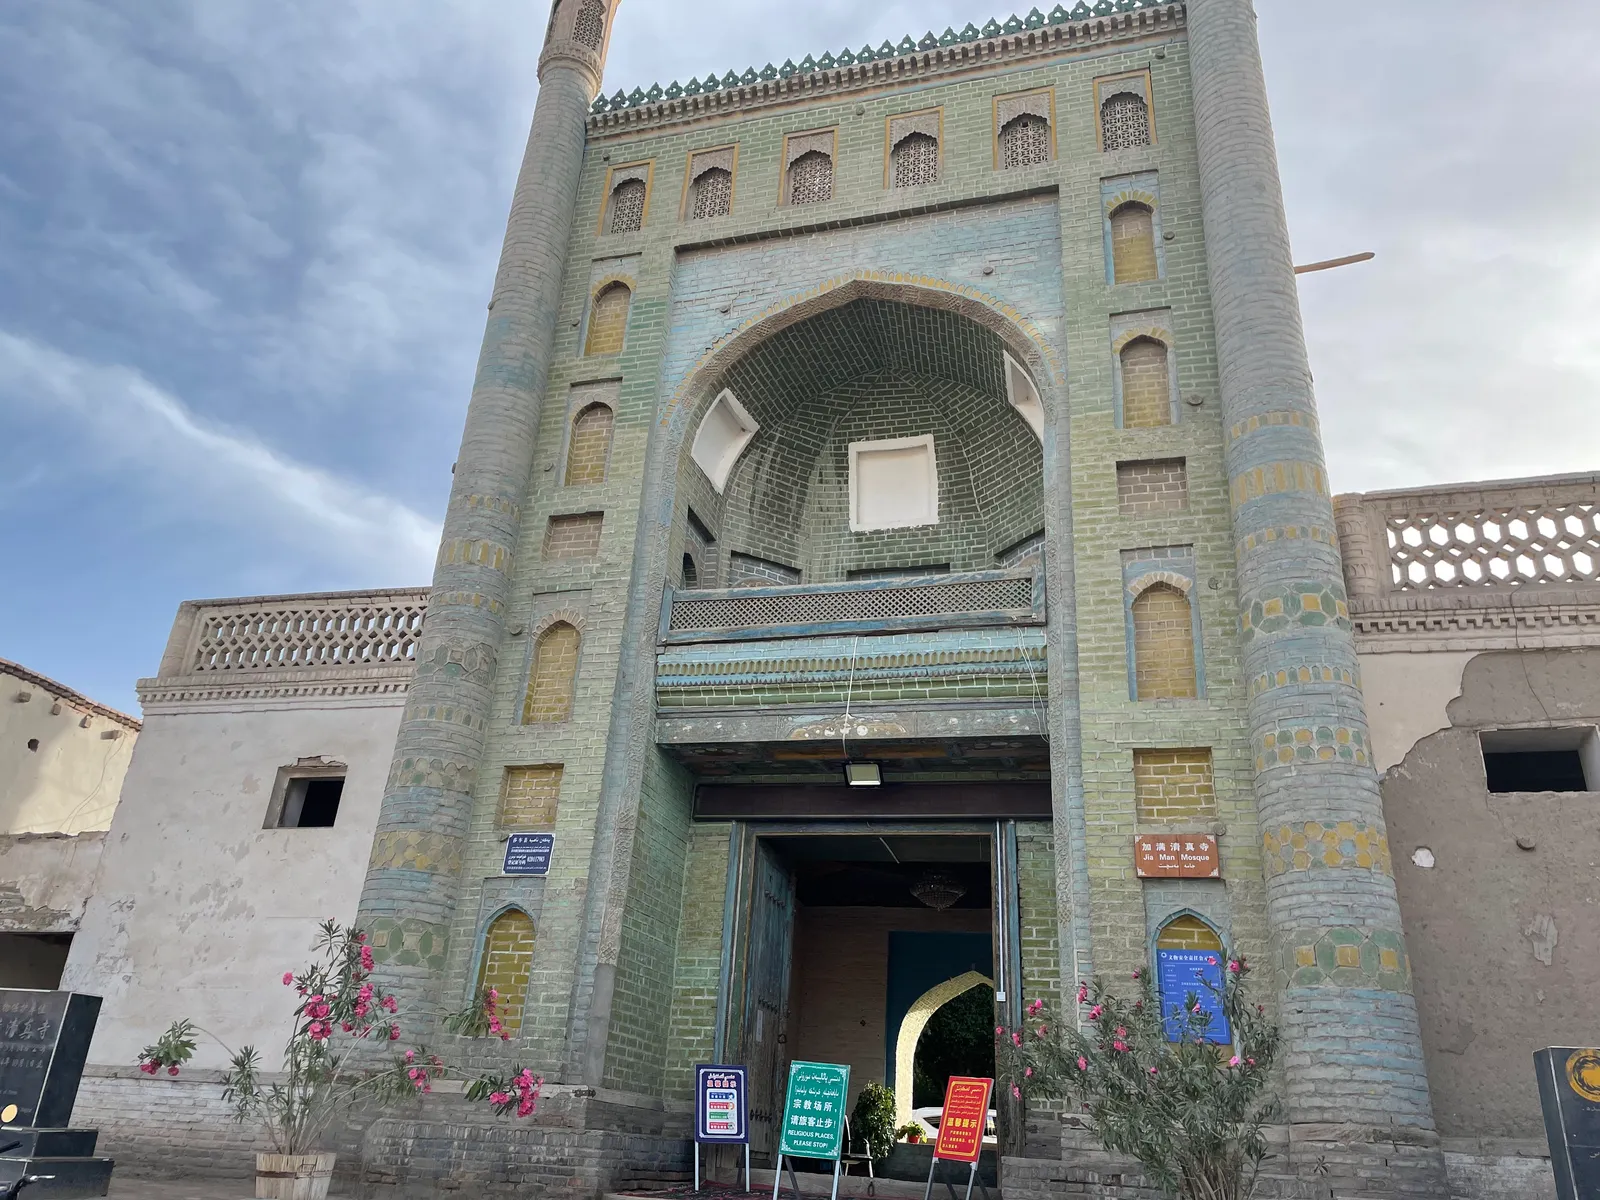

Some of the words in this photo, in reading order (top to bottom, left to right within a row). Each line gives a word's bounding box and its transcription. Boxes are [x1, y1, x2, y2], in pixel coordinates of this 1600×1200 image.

[1142, 842, 1209, 852] 加满清真寺
